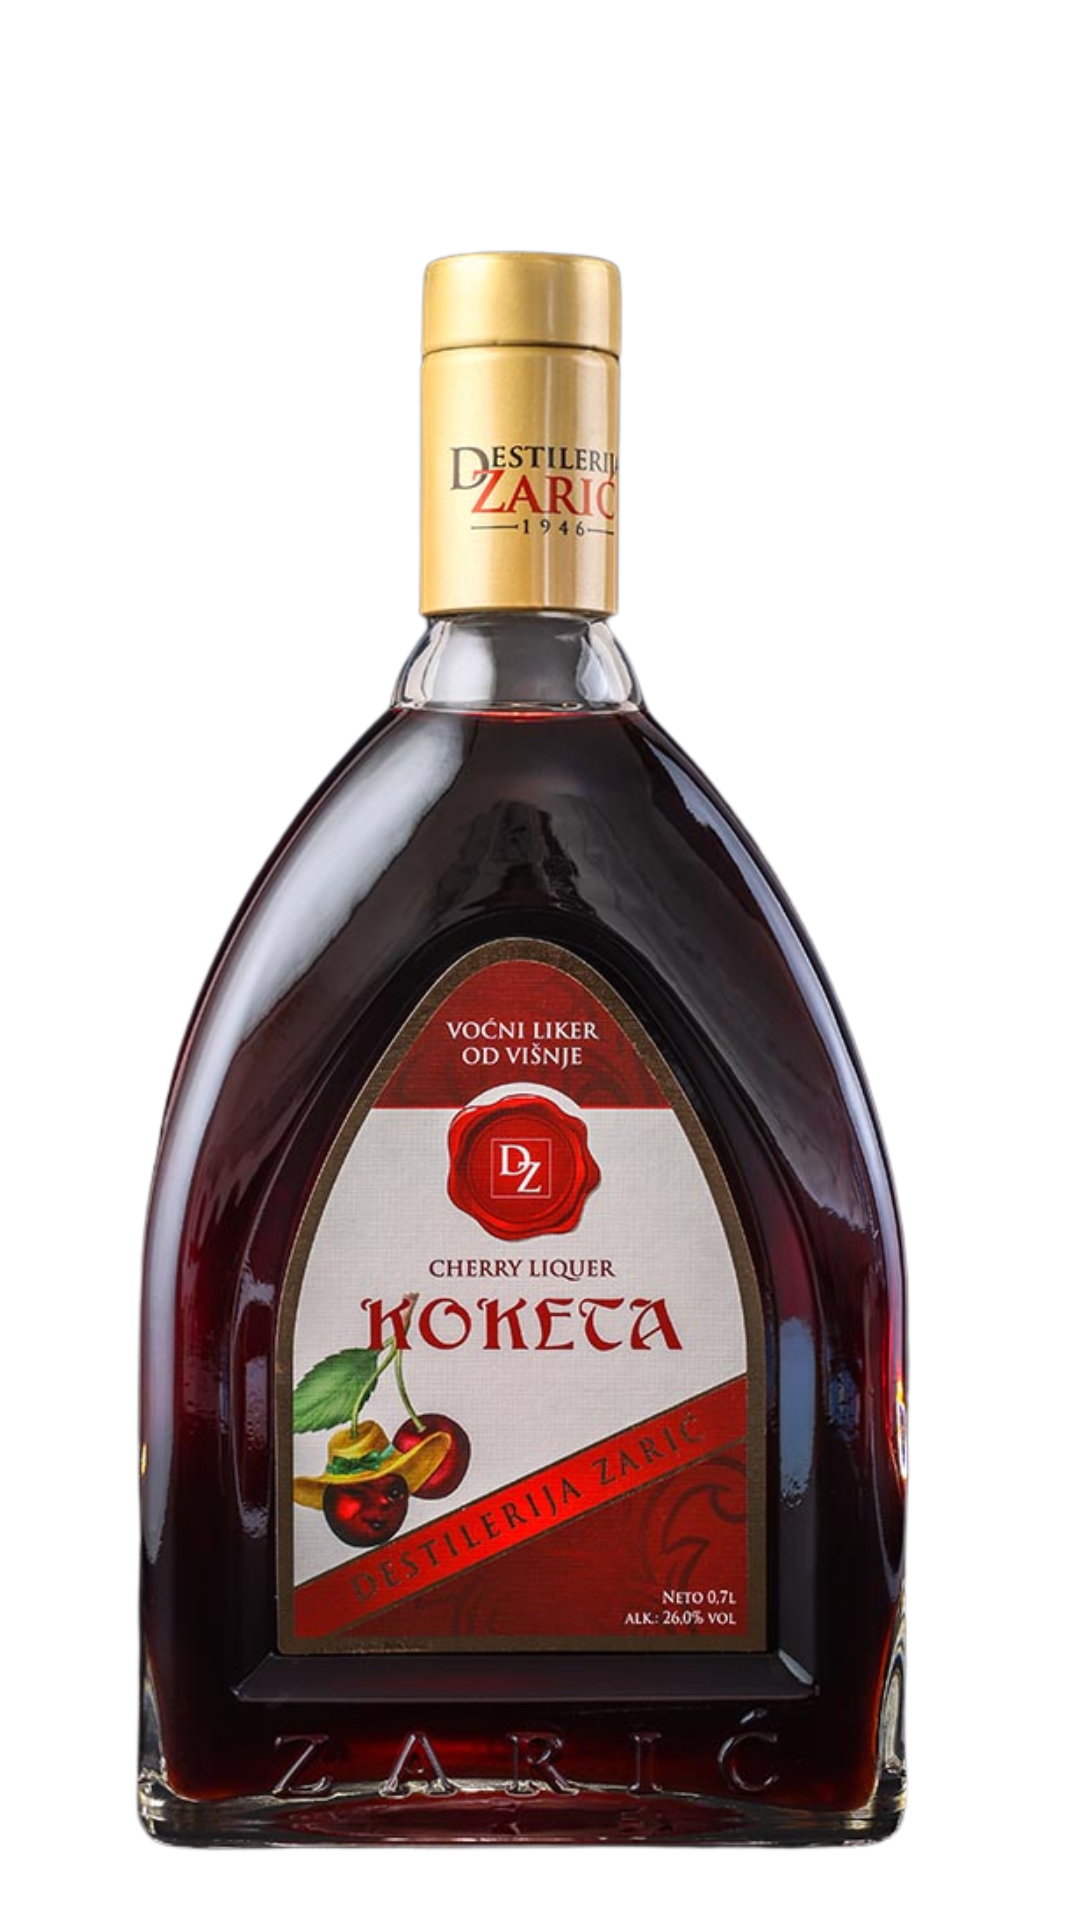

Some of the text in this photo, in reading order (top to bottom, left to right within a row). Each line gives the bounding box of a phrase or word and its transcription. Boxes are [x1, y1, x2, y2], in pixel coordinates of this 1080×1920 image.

[447, 1017, 599, 1040] VOĆNI LIKER
[462, 1042, 583, 1070] OD VIŠNJE
[499, 1143, 542, 1194] DZ
[428, 1259, 616, 1282] CHERRY LIQUER
[360, 1296, 684, 1351] KOKETA
[350, 1412, 705, 1602] DESTILERIJA ZARIĆ
[271, 1707, 782, 1798] ZARIĆ
